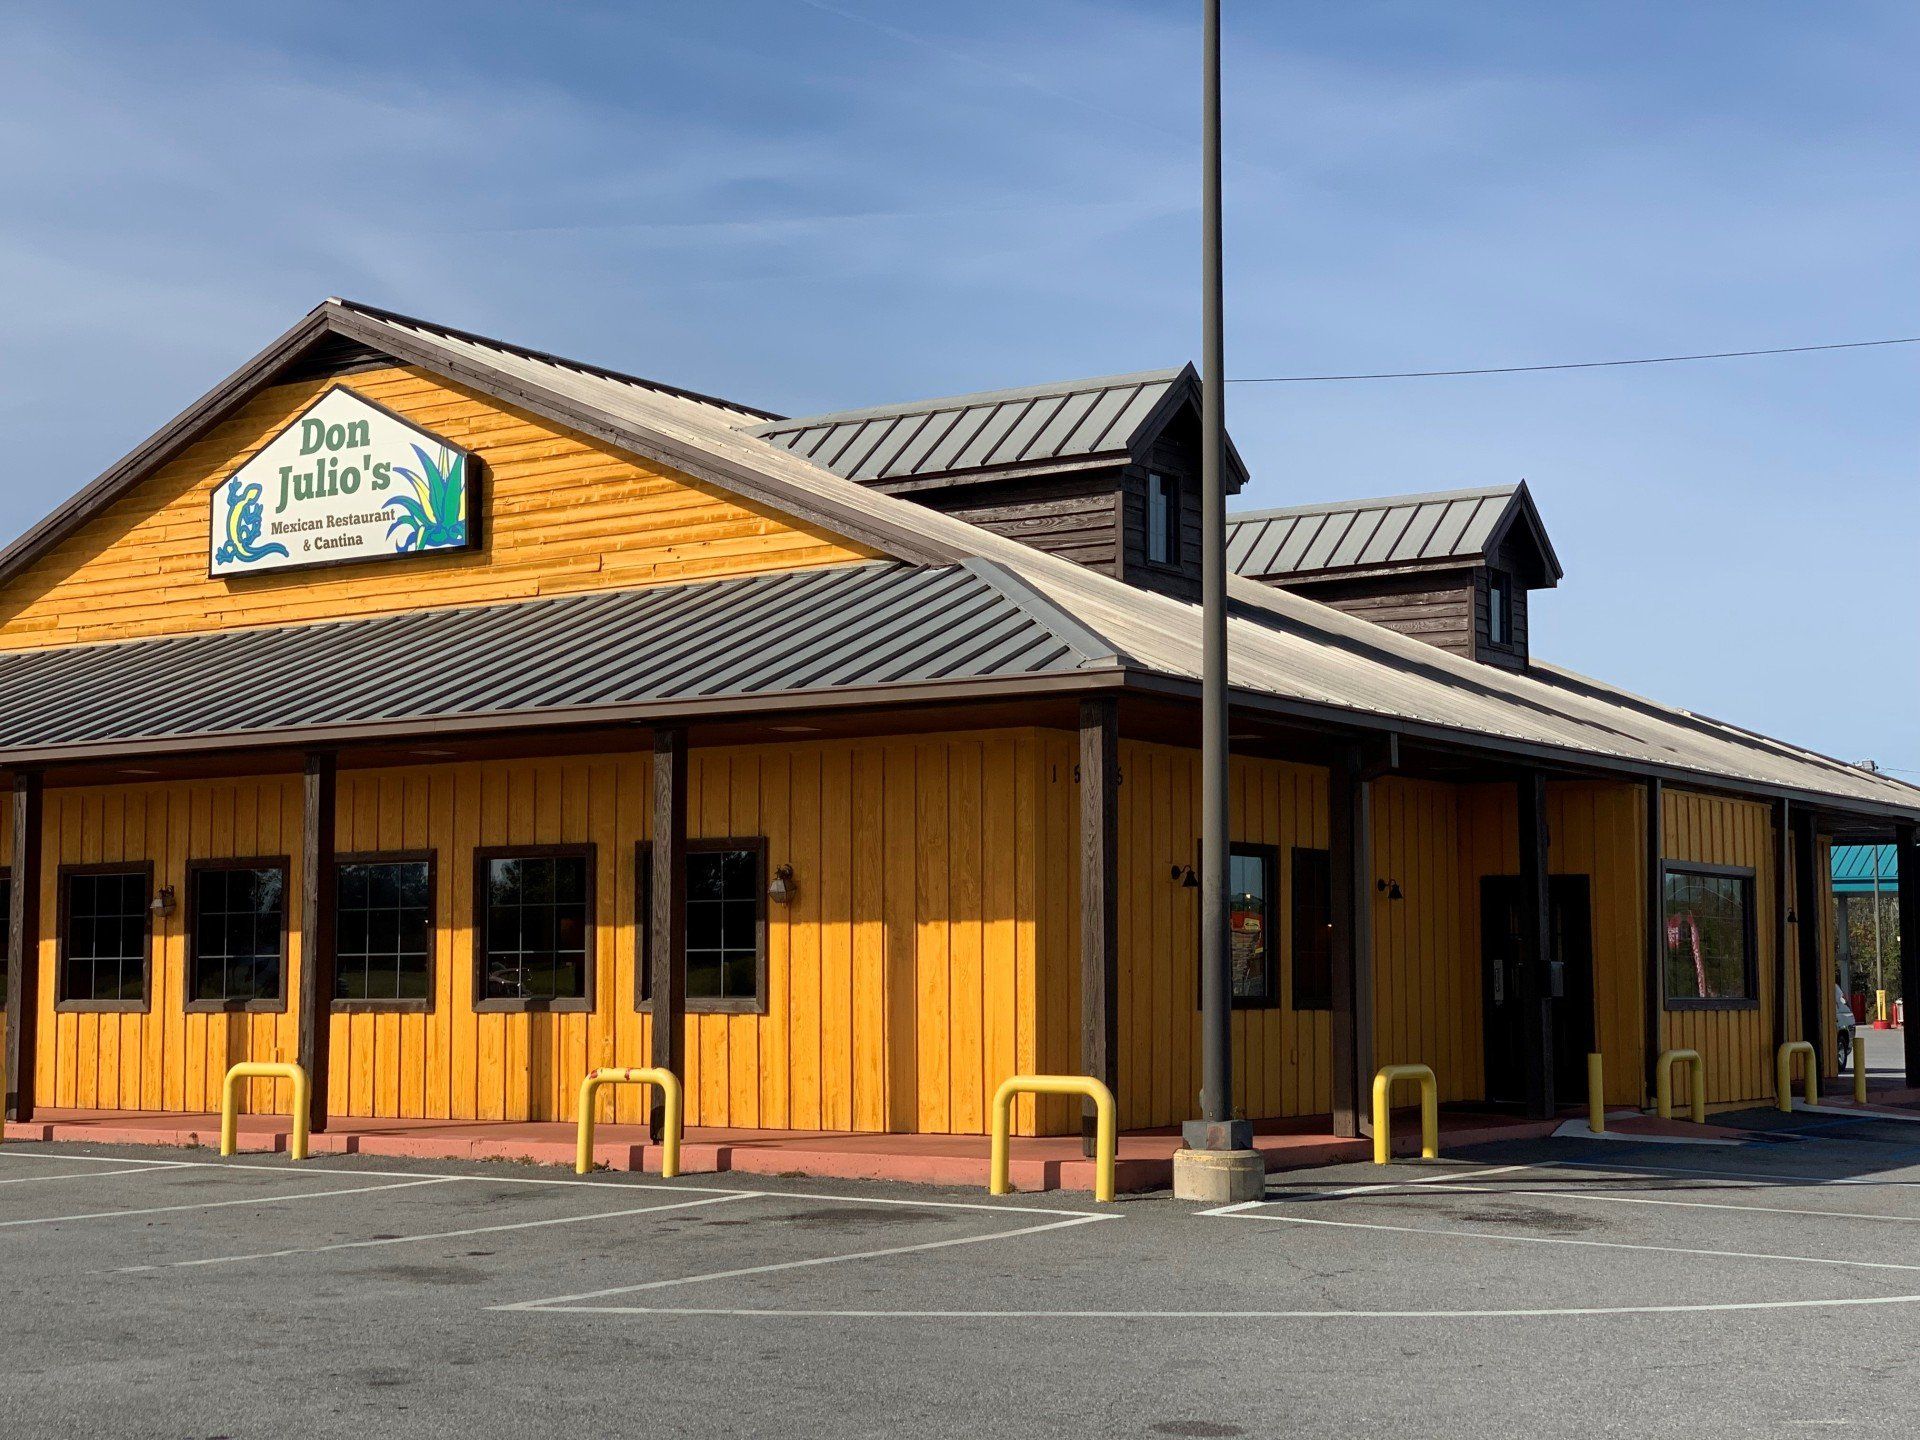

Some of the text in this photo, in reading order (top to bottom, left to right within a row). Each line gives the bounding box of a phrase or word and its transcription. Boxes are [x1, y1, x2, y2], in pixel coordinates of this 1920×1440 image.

[301, 418, 370, 456] Don
[275, 454, 391, 514] Julio's
[271, 508, 396, 535] Mexican Restaurant
[303, 533, 363, 551] & Cantina
